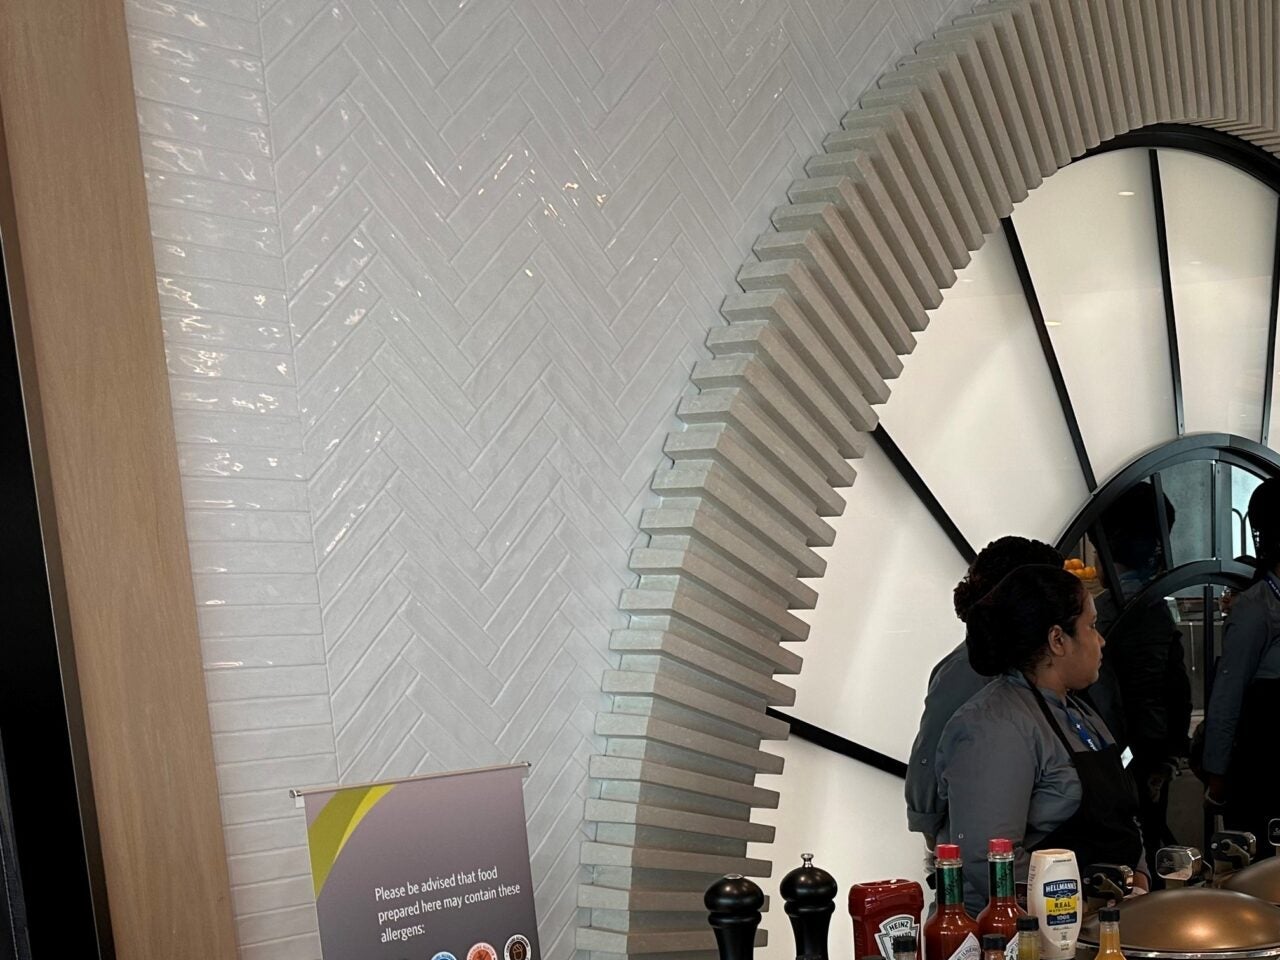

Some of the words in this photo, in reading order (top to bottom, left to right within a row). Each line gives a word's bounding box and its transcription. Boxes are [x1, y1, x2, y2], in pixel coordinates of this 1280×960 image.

[375, 887, 406, 901] Please
[407, 882, 419, 896] be
[421, 874, 456, 892] advised
[458, 871, 476, 886] that
[478, 866, 498, 881] food
[378, 902, 420, 925] prepared
[421, 900, 442, 913] here
[443, 896, 463, 909] may
[464, 888, 497, 904] contain
[498, 880, 520, 897] these
[381, 924, 425, 943] allergens:
[889, 920, 909, 931] HEINZ
